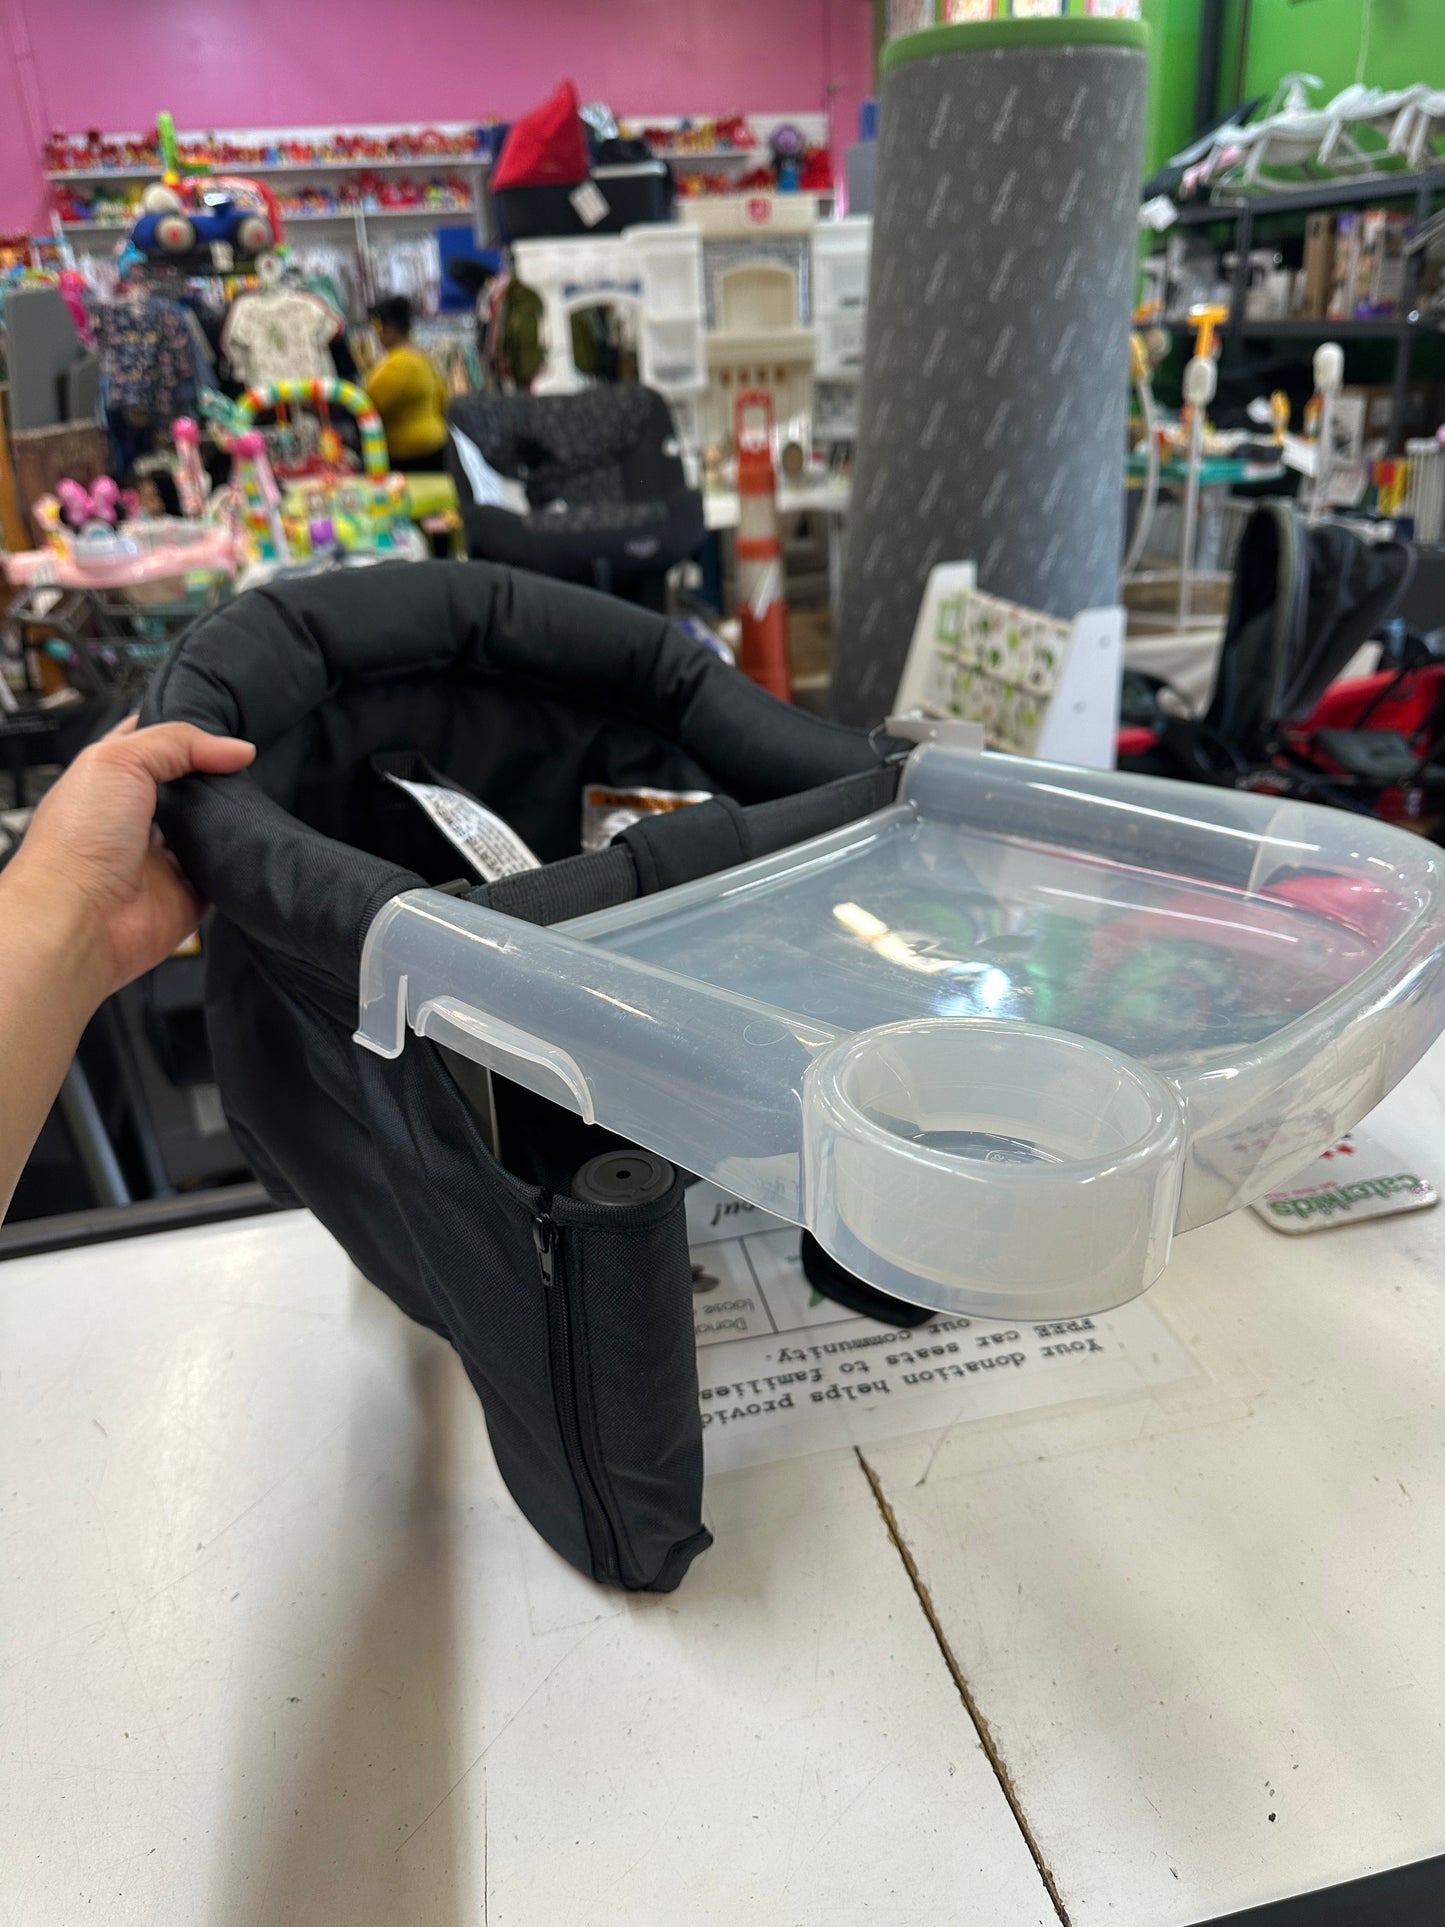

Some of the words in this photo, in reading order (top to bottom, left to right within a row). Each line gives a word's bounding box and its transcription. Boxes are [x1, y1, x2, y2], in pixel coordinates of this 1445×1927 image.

[709, 1200, 756, 1227] ou!
[694, 1317, 747, 1336] Dona
[928, 1318, 972, 1335] our
[1033, 1318, 1096, 1338] FREE
[765, 1329, 912, 1363] community.
[975, 1330, 1020, 1347] car
[1039, 1338, 1103, 1358] Your
[886, 1342, 960, 1365] seats
[839, 1360, 870, 1373] to
[902, 1352, 1026, 1385] donation
[701, 1367, 824, 1401] families
[810, 1380, 890, 1403] helps
[700, 1394, 795, 1429] provid
